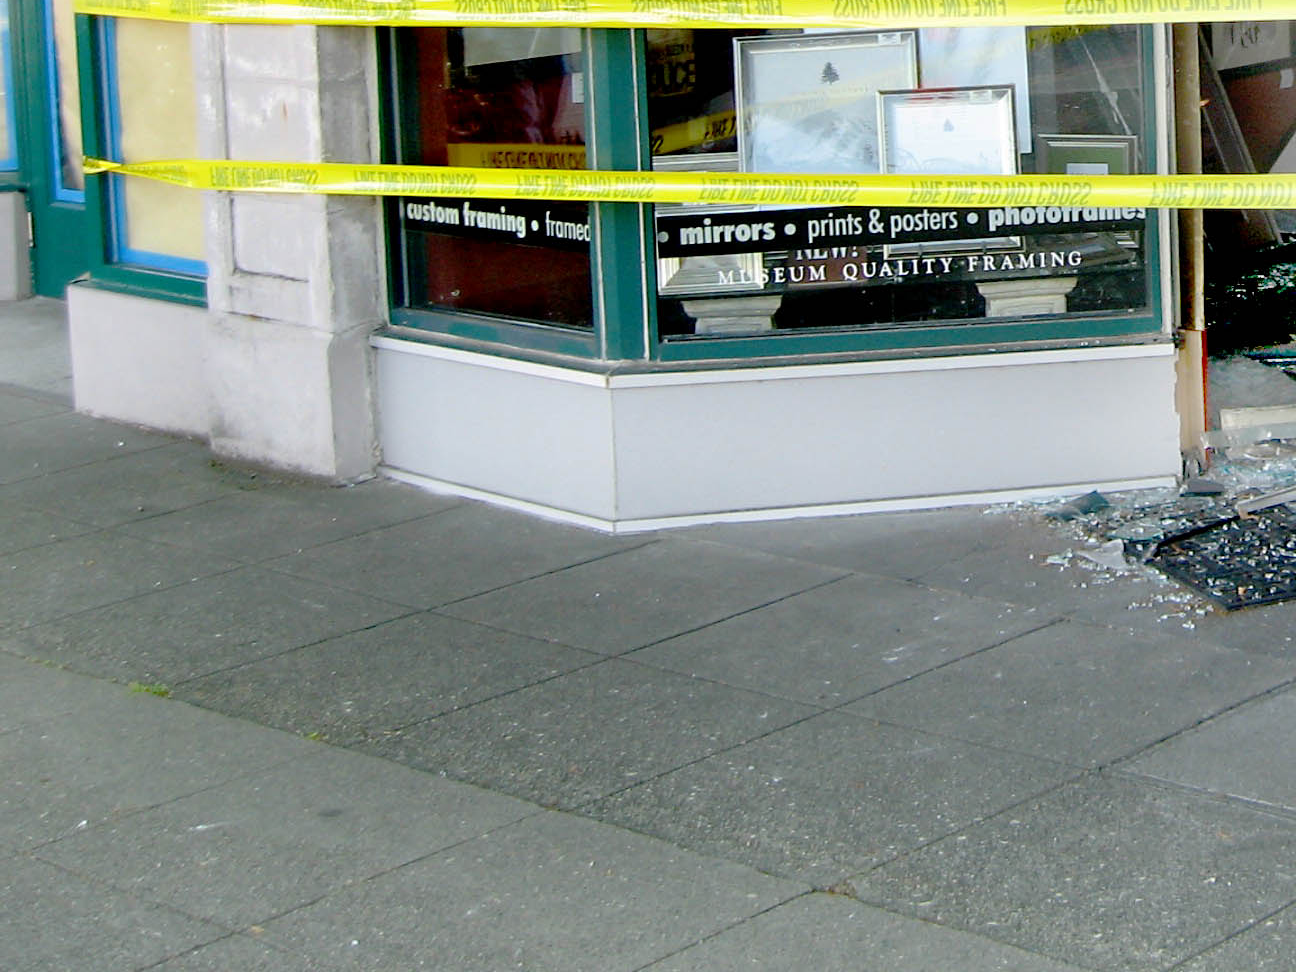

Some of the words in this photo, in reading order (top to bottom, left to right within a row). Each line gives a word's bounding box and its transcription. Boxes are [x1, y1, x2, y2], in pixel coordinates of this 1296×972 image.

[406, 202, 460, 225] custom
[463, 201, 526, 239] framing
[679, 217, 776, 245] mirrors
[807, 212, 863, 243] prints
[868, 208, 885, 235] &
[890, 209, 959, 238] posters
[718, 264, 827, 285] MUSEUM
[842, 258, 953, 282] QUALITY
[968, 250, 1082, 273] FRAMING
